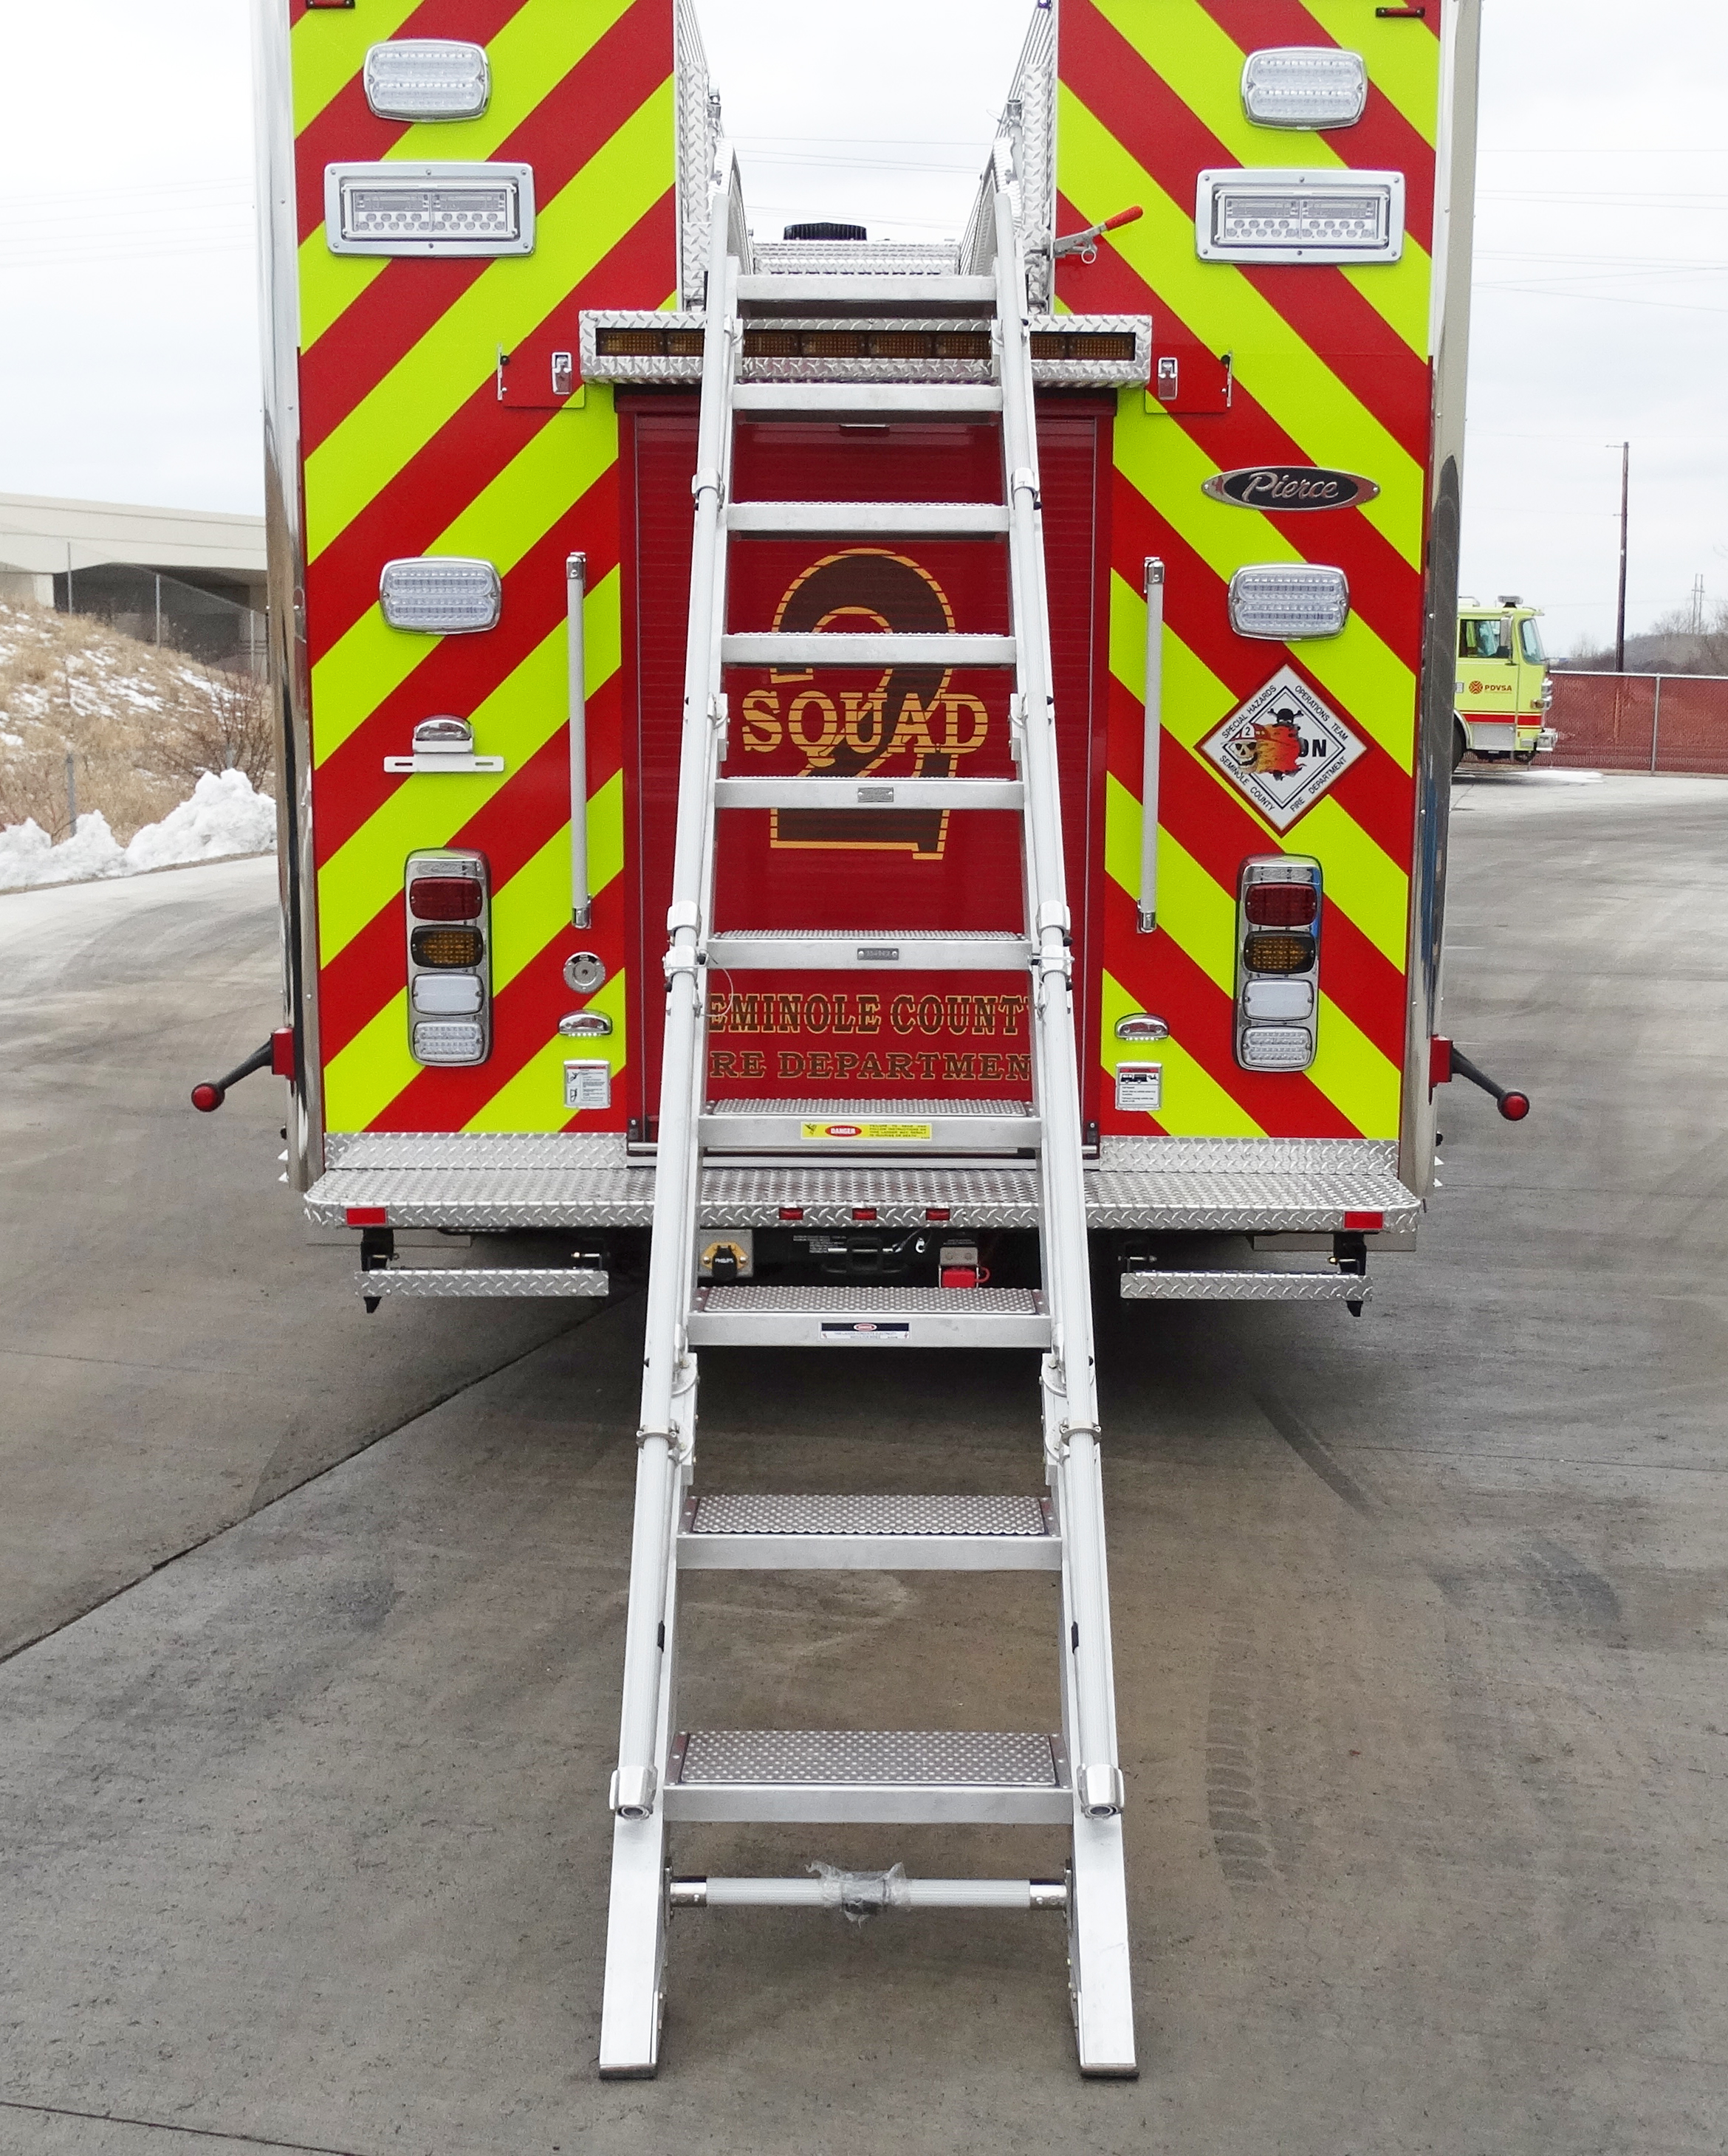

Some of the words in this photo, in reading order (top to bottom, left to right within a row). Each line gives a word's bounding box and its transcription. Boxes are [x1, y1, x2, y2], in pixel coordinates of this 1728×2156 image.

[1241, 471, 1339, 503] Pierce
[741, 690, 989, 768] SQUAD
[770, 547, 955, 861] 2
[1221, 713, 1248, 739] SPECIAL
[1247, 684, 1277, 715] HAZARDS
[1245, 726, 1251, 736] 2
[1295, 685, 1330, 722] OPERATIONS
[1331, 722, 1348, 741] TEAM
[1219, 755, 1250, 786] SEMINOLE
[1249, 786, 1275, 811] COUNTY
[1289, 797, 1305, 812] FIRE
[1308, 757, 1347, 794] DEPARTMENT
[707, 993, 882, 1034] EMINOLE
[709, 1051, 767, 1079] RE
[778, 1051, 1032, 1081] DEPARTMEN
